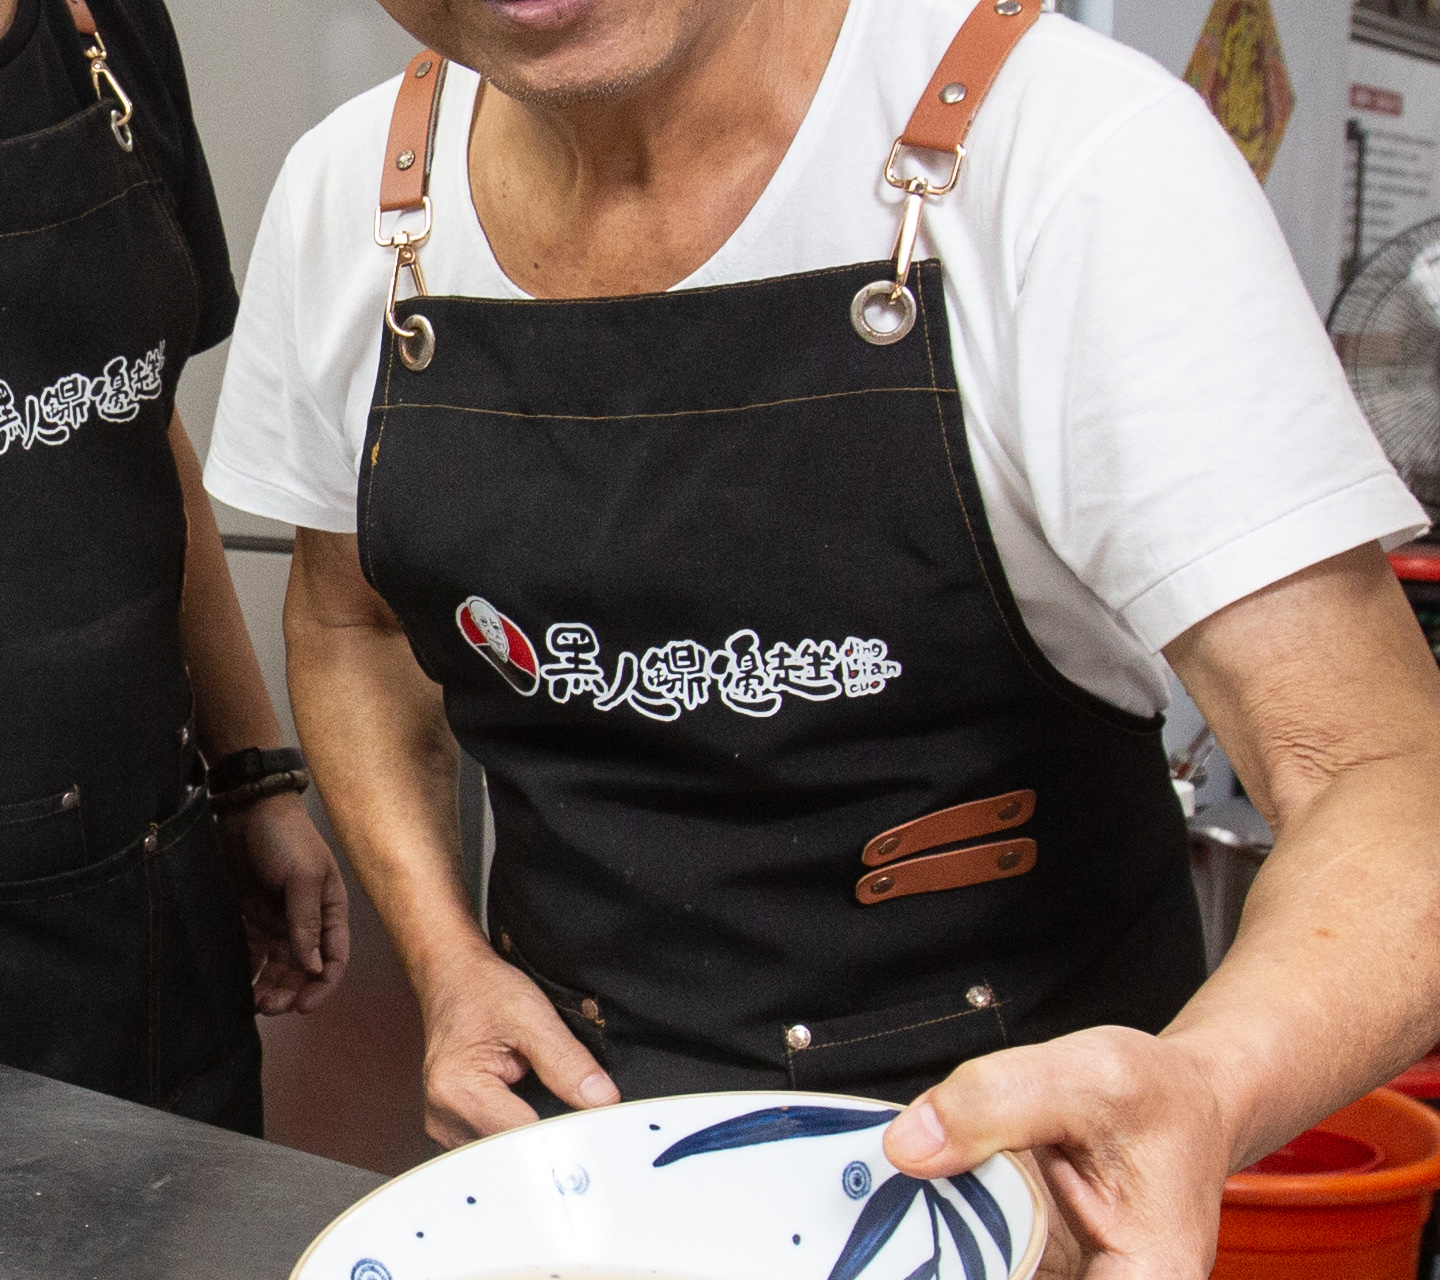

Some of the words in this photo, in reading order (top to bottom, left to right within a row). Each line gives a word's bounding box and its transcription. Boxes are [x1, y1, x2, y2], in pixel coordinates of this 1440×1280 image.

[844, 640, 883, 658] ding
[846, 658, 898, 680] bian
[849, 680, 881, 693] cuo
